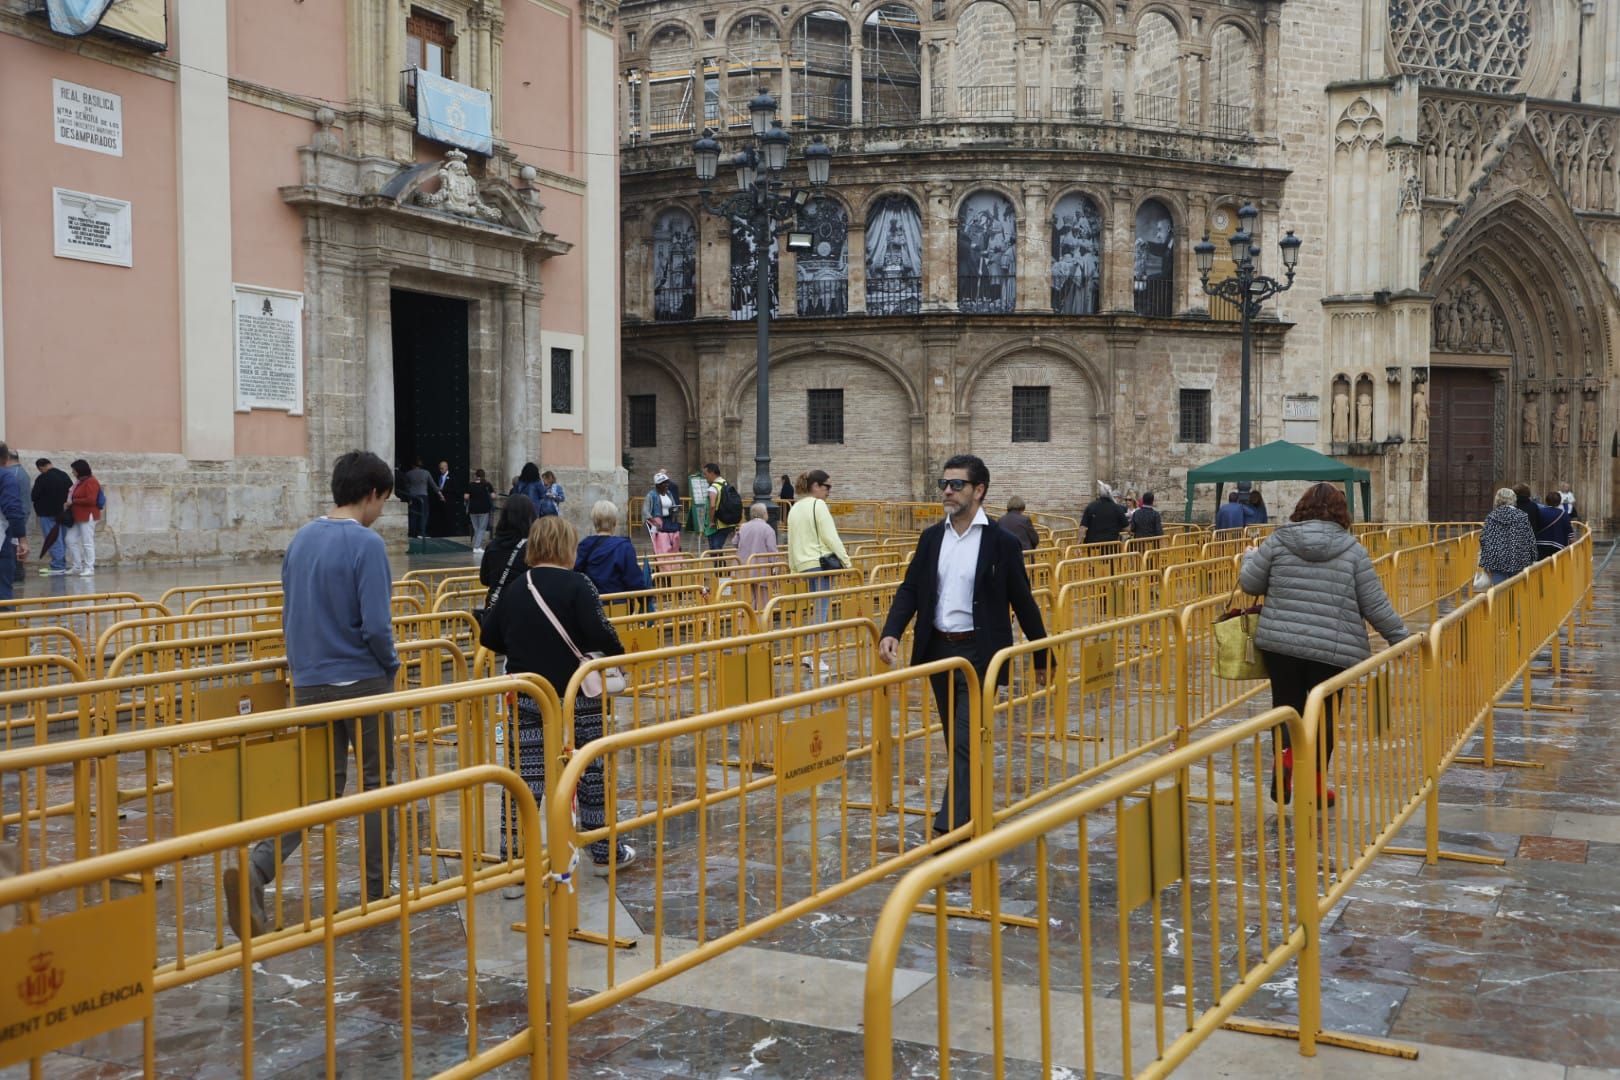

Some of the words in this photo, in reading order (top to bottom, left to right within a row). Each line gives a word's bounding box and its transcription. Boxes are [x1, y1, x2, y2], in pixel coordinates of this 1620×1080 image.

[61, 88, 80, 102] REAL
[83, 93, 114, 111] BASILICA
[109, 121, 119, 129] LOS
[61, 127, 117, 149] DESAMPARADOS
[45, 1007, 68, 1026] DE
